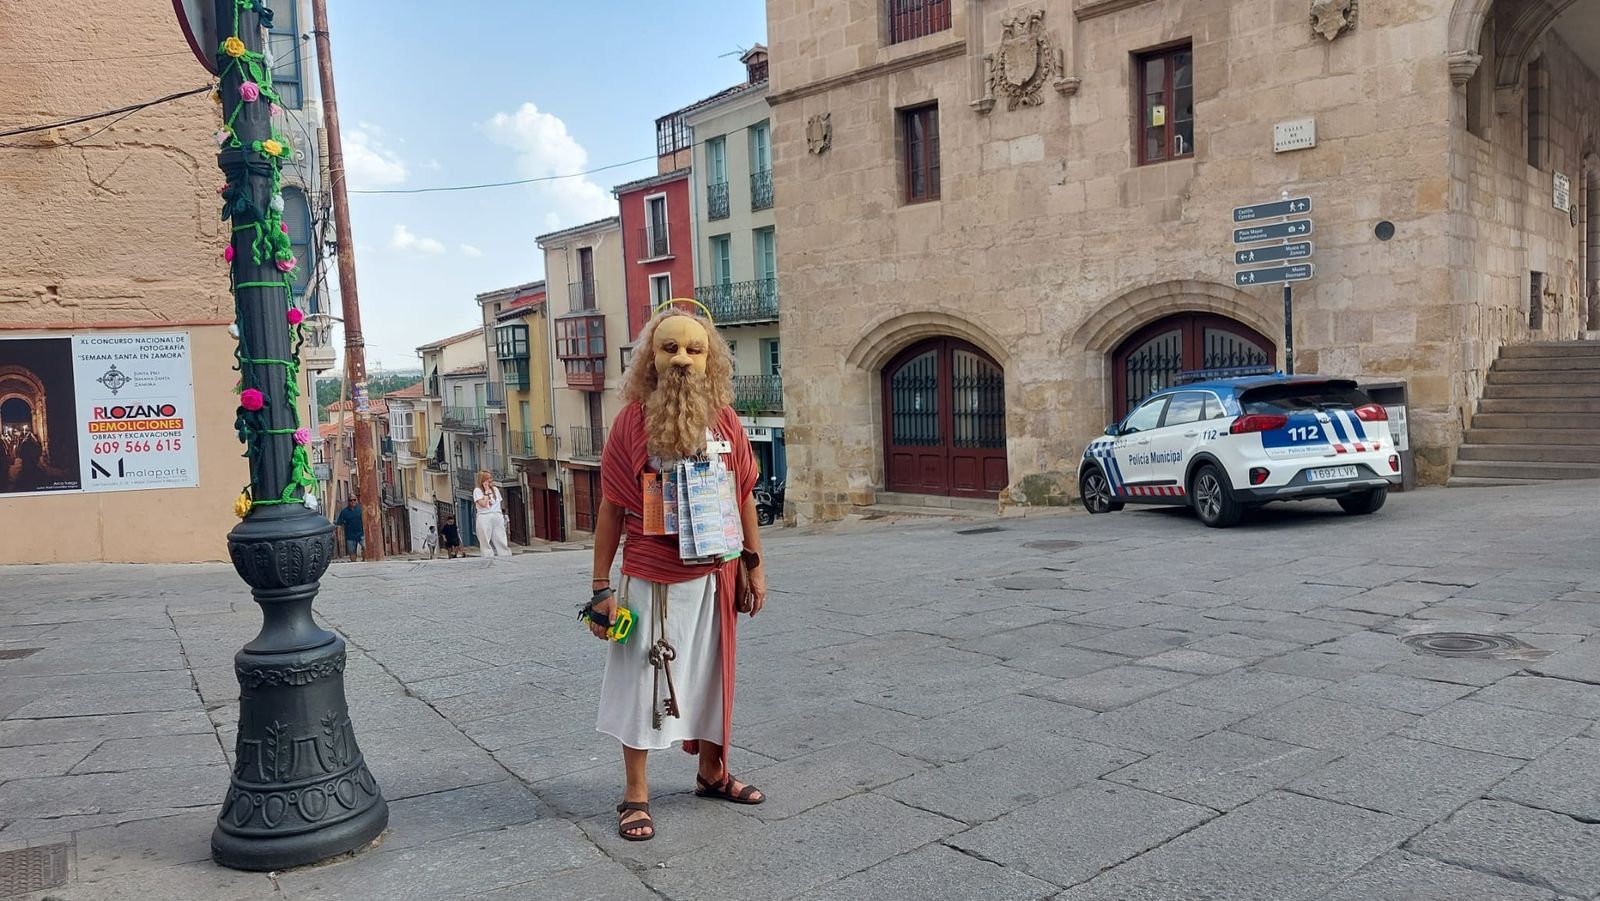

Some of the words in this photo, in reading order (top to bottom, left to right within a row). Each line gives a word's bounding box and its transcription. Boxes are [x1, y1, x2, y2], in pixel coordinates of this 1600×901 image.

[140, 344, 185, 352] FOTOGRAFÍA
[94, 404, 176, 420] RLOZANO
[91, 420, 181, 432] DEMOLICIONES
[1203, 430, 1217, 440] 112
[1288, 426, 1319, 441] 112
[94, 442, 119, 454] 609
[125, 440, 150, 453] 566
[156, 439, 181, 452] 615
[1129, 453, 1149, 465] Policía
[1151, 449, 1183, 465] Municipal
[125, 468, 187, 479] malaparte
[1313, 468, 1336, 479] 1692
[1338, 466, 1356, 478] LVK
